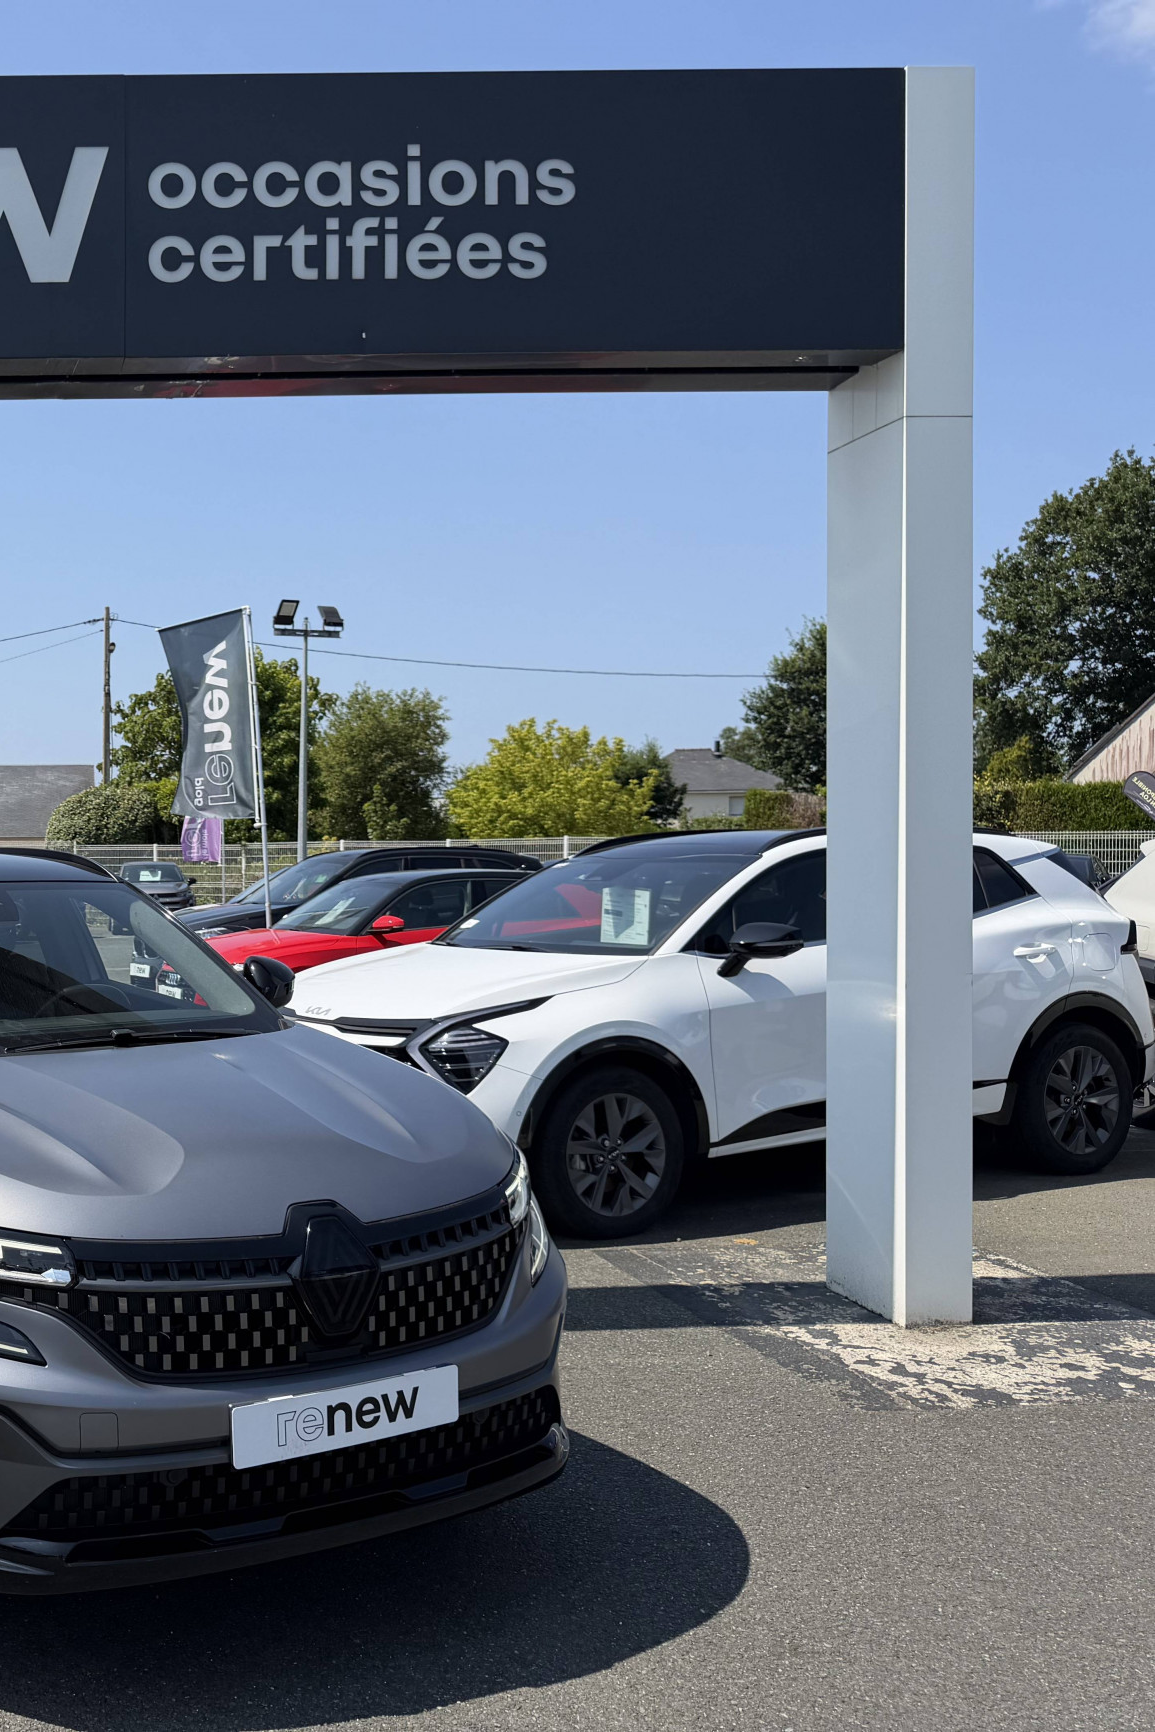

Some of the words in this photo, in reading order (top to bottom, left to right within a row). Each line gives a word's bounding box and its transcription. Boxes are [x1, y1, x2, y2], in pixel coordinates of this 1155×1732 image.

[147, 144, 576, 209] occasions
[148, 216, 547, 283] certifiées
[277, 1386, 419, 1447] renew
